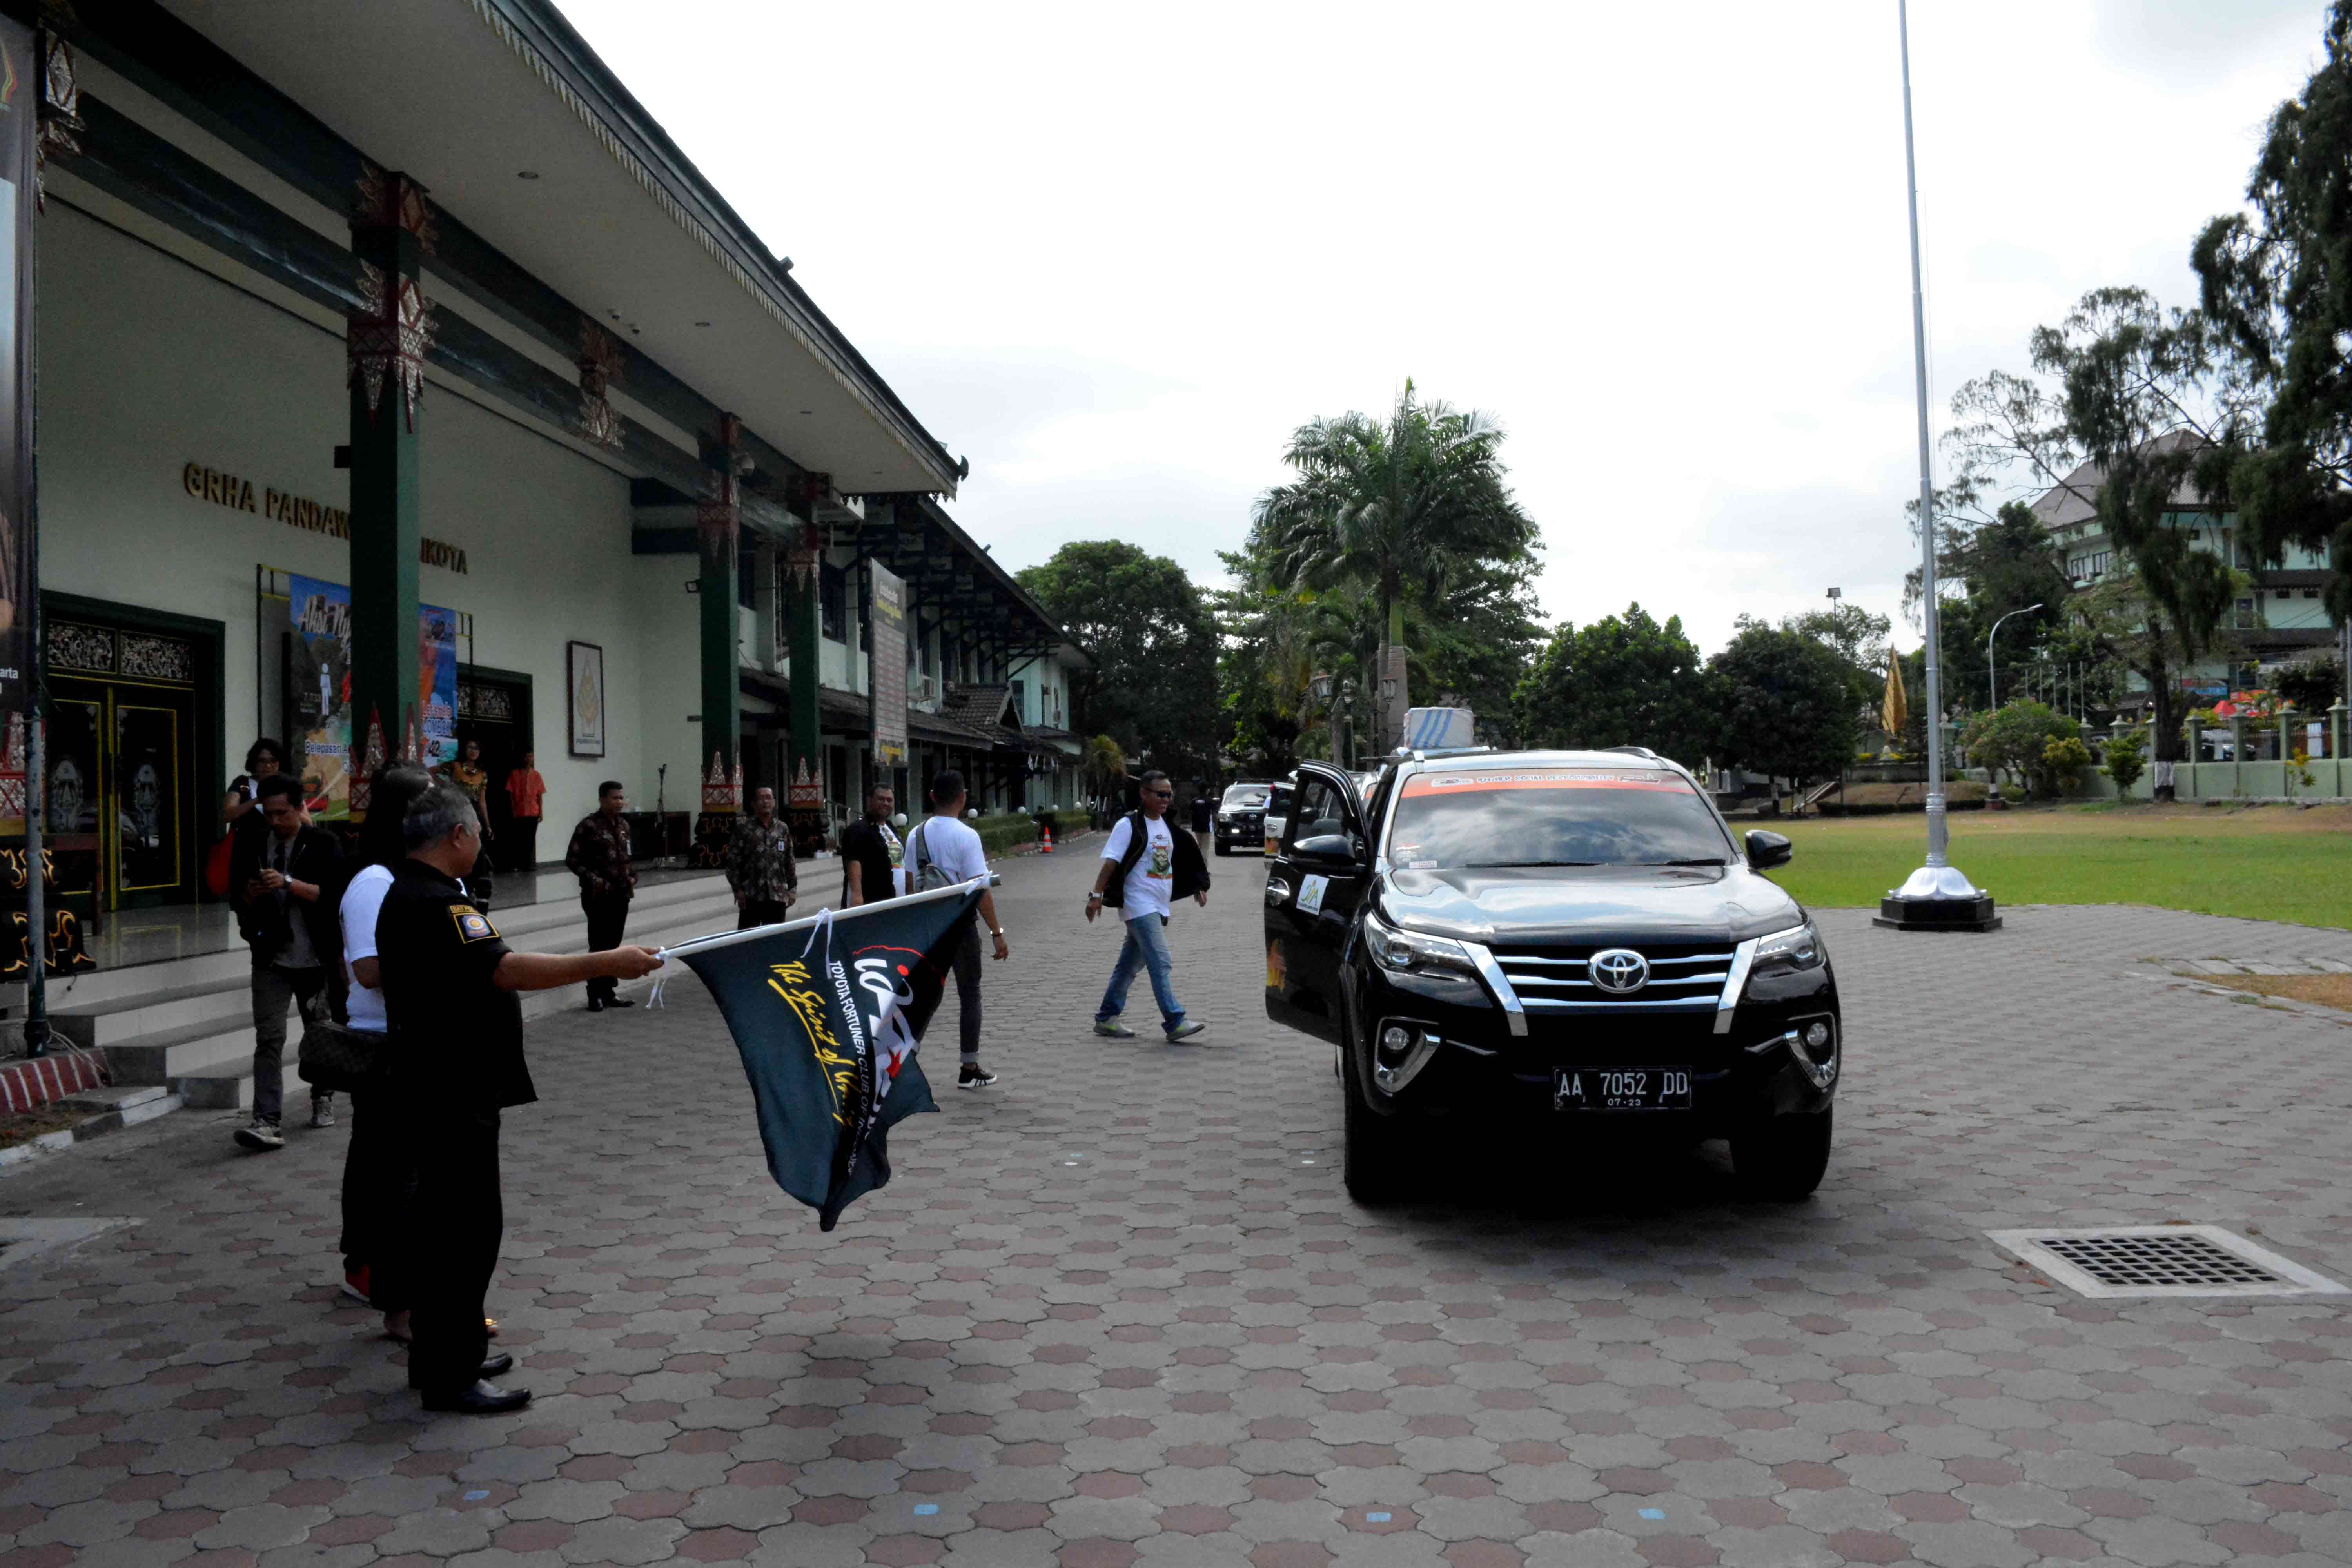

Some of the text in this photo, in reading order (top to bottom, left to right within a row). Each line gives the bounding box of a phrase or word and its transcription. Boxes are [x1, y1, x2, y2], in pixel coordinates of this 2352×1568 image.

[182, 462, 468, 575] GRHA PANDAW IKOTA
[770, 960, 811, 984] The
[829, 960, 850, 1001] TOYOTA
[789, 988, 841, 1046] Spirit
[842, 996, 866, 1054] FORTUNER
[815, 1047, 856, 1066] of
[858, 1058, 869, 1094] CLUB
[1559, 1072, 1688, 1096] AA 7052 DD
[860, 1095, 869, 1116] OF
